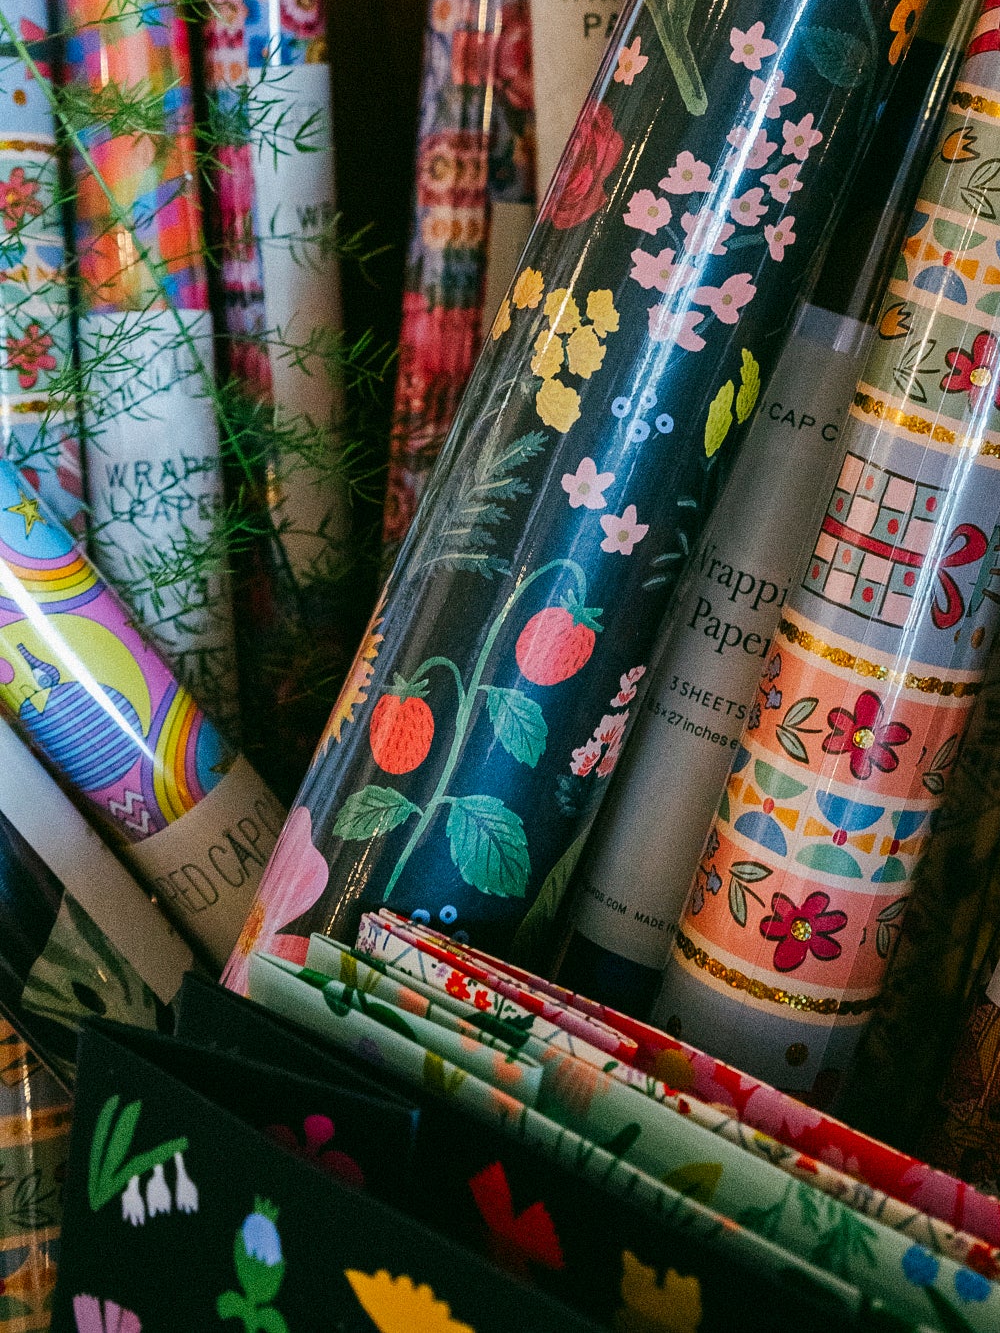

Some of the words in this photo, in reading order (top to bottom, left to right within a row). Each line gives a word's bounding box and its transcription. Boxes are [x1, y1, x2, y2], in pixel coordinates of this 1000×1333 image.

[769, 403, 816, 430] CAP
[670, 675, 678, 691] 3
[679, 682, 749, 720] SHEETS
[667, 710, 683, 726] 27
[682, 718, 728, 747] inches
[208, 817, 268, 888] CAP
[633, 911, 666, 931] MADE
